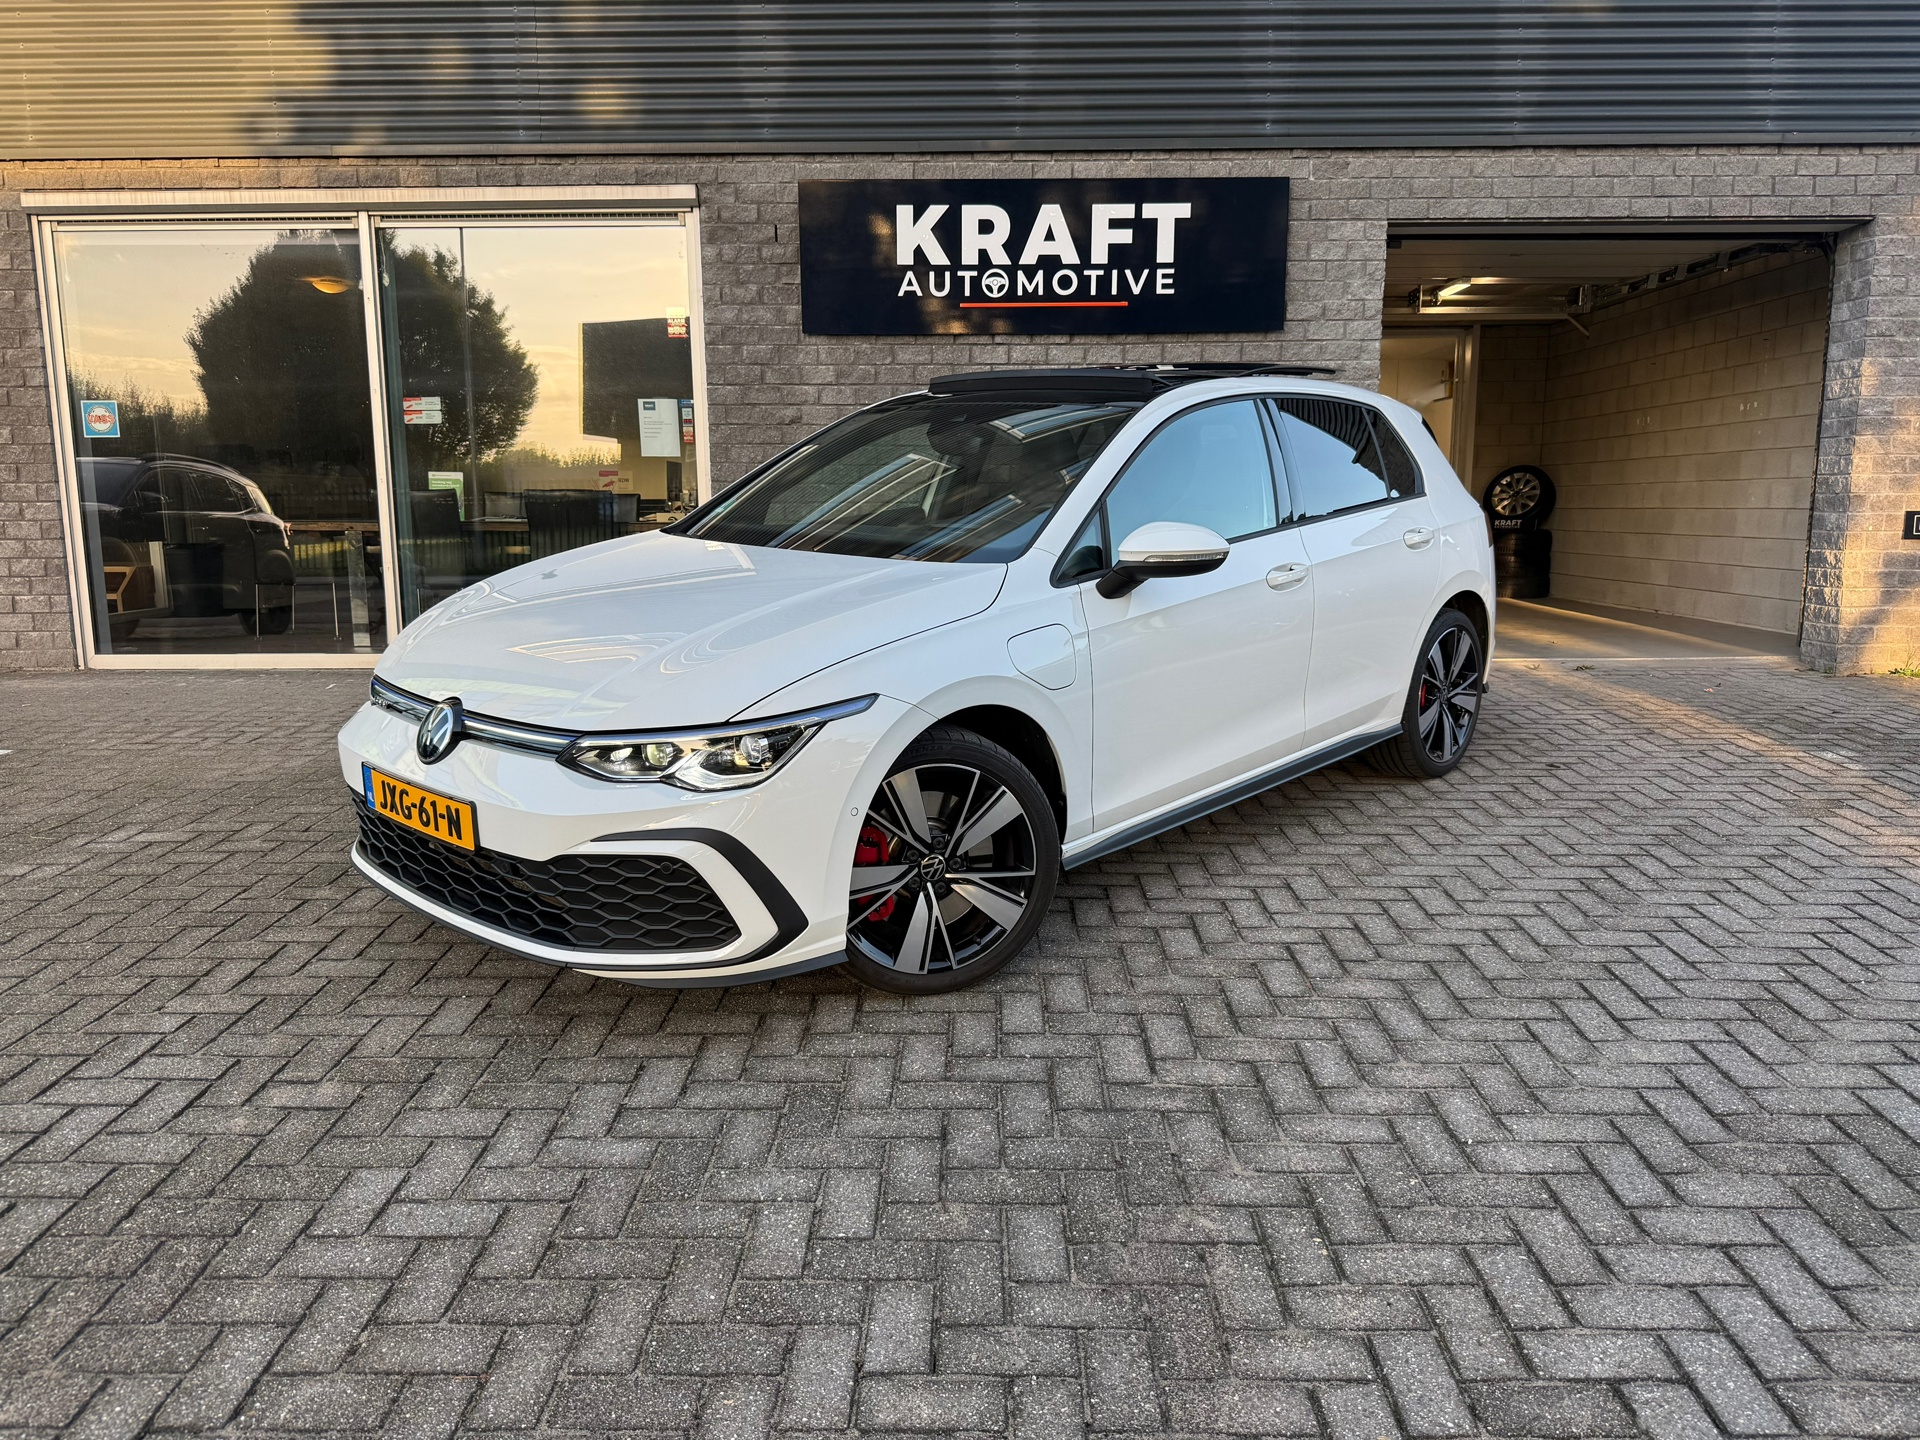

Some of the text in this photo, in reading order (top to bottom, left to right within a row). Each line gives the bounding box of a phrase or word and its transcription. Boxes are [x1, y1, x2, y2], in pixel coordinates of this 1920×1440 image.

[896, 203, 1192, 266] KRAFT
[898, 268, 1175, 298] AUTOMOTIVE
[1494, 519, 1522, 527] KRAFT
[380, 780, 463, 841] JXG-61-N
